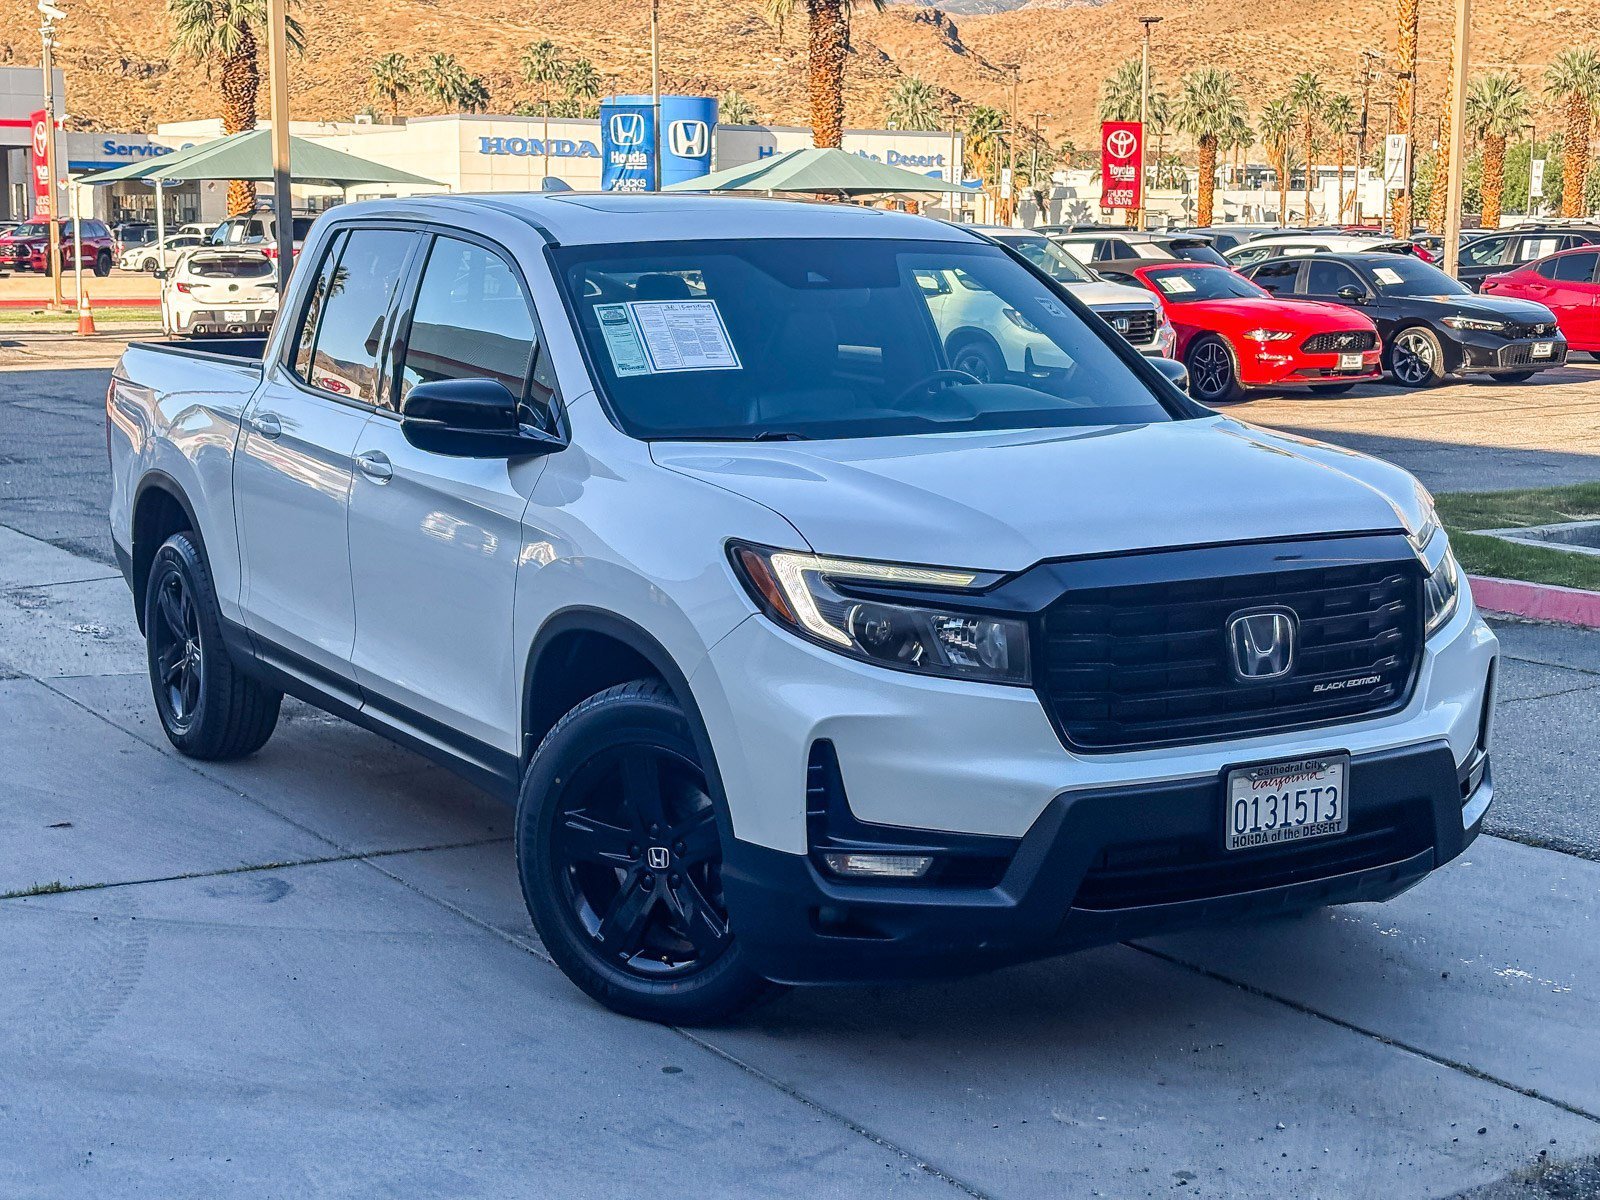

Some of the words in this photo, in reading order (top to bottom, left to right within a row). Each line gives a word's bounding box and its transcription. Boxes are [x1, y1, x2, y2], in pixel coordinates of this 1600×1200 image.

[479, 136, 602, 158] HONDA
[887, 150, 945, 167] Desert
[1109, 164, 1135, 176] Toyota
[1107, 190, 1133, 198] TRUCKS
[1313, 680, 1347, 693] BLACK
[1346, 674, 1381, 688] EDITION
[1257, 763, 1303, 776] Cathedral
[1305, 760, 1322, 771] City
[1234, 786, 1338, 835] 01315T3
[1232, 832, 1269, 848] HONDA
[1271, 832, 1282, 841] of
[1284, 828, 1300, 840] the
[1302, 821, 1342, 837] DESERT
